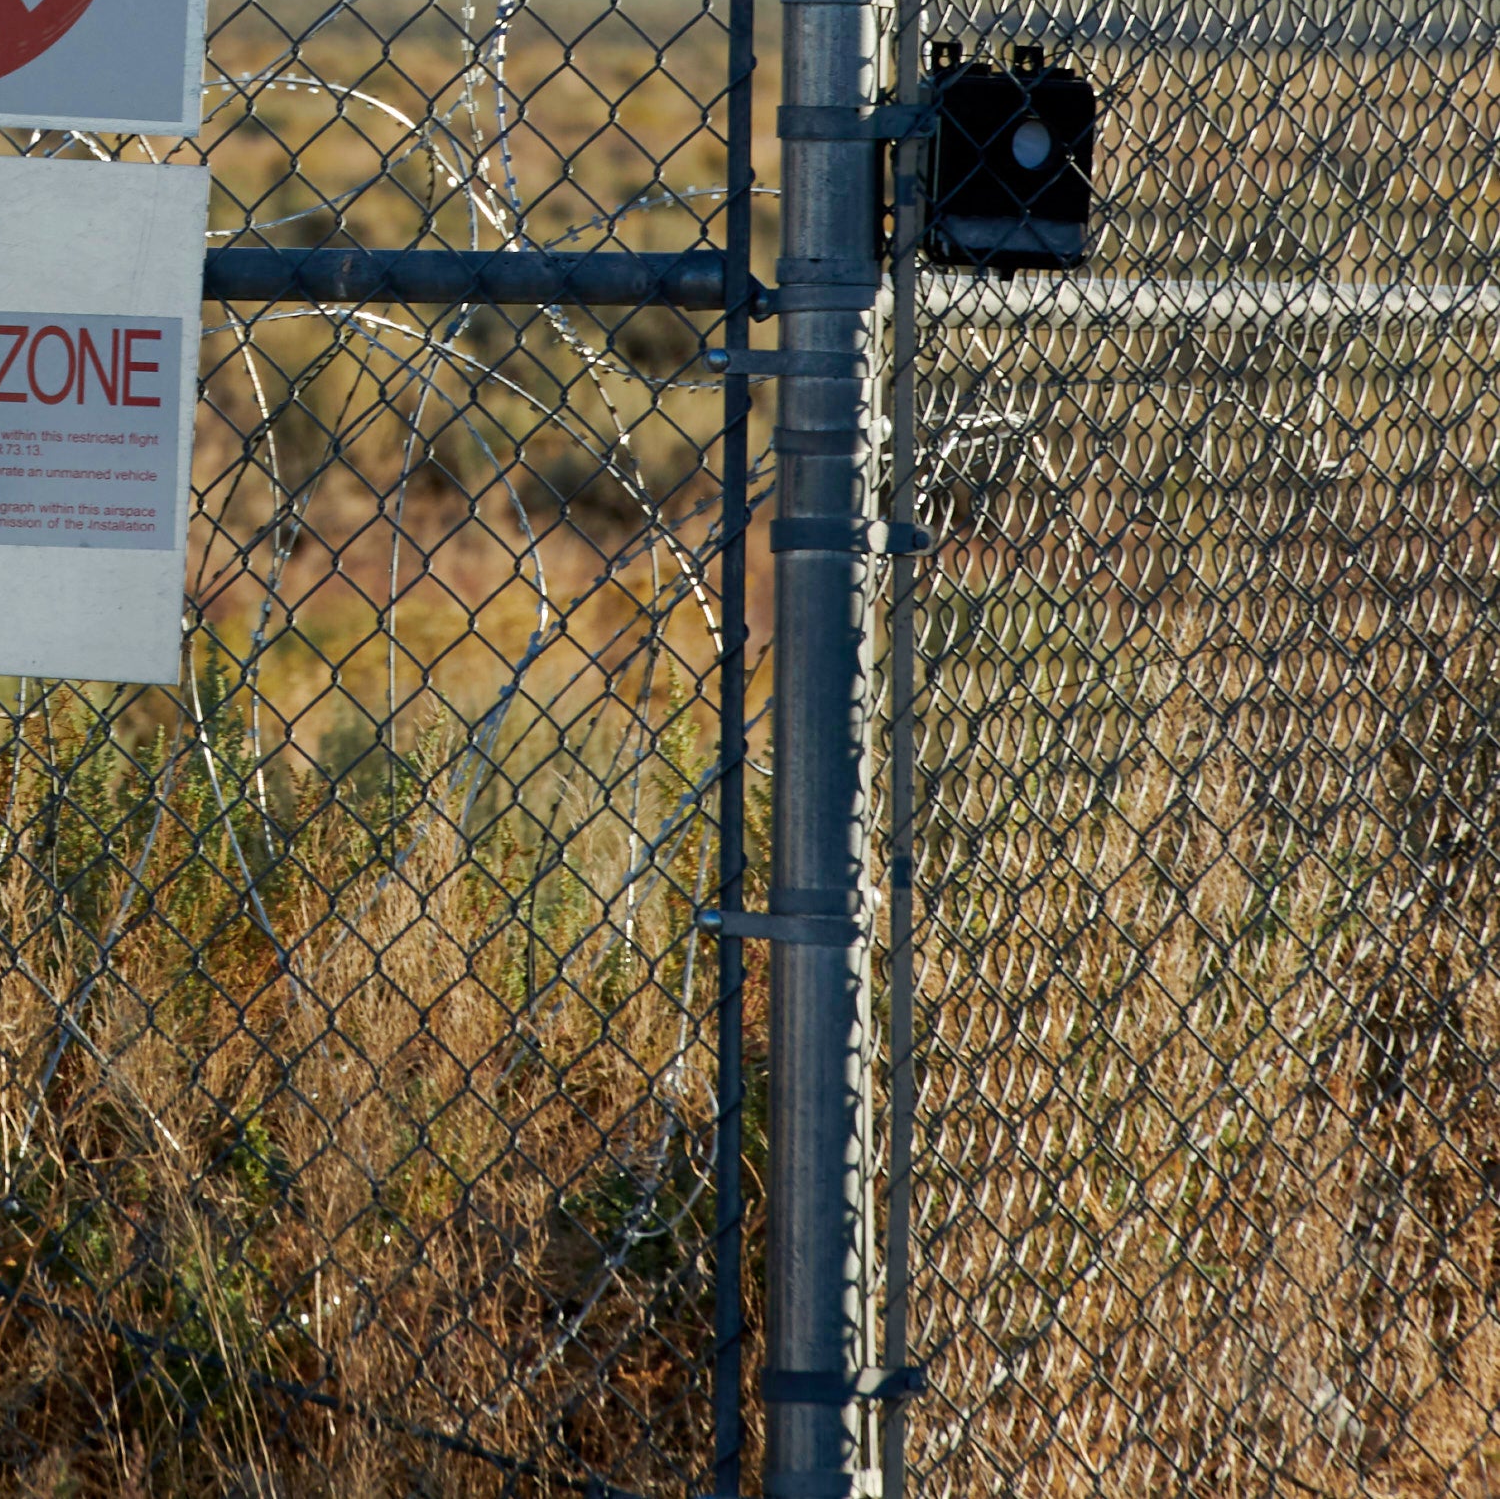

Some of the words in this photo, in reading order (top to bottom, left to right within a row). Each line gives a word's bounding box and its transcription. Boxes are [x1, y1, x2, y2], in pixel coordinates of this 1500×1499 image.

[1, 429, 37, 442] within
[41, 430, 63, 442] this
[68, 431, 124, 445] restricted
[129, 433, 159, 448] flight
[27, 468, 44, 478] an
[46, 468, 111, 481] unmanned
[114, 469, 157, 482] vehicle
[39, 501, 75, 514] within
[78, 502, 99, 515] this
[104, 504, 156, 519] airspace
[47, 517, 60, 529] of
[64, 517, 84, 530] the
